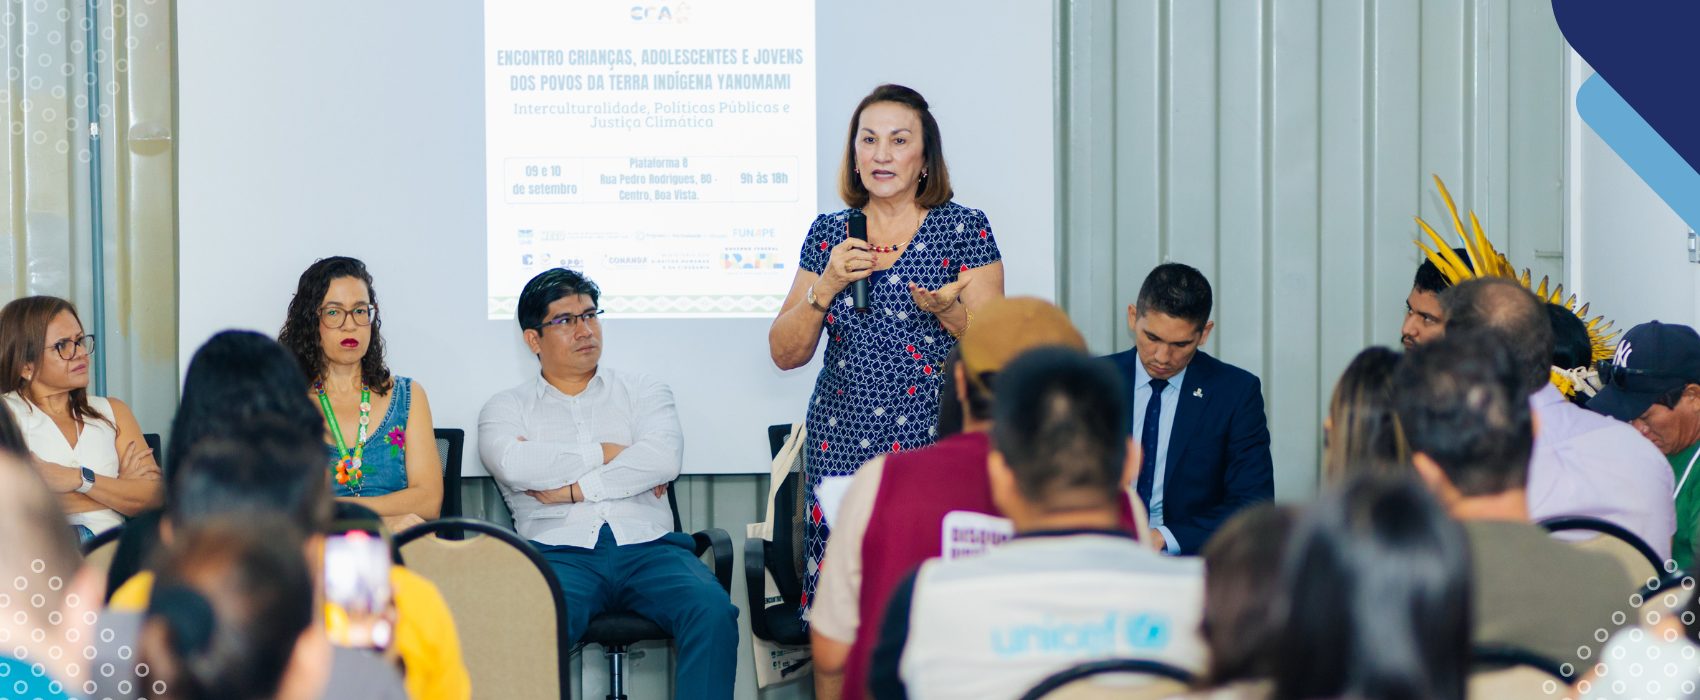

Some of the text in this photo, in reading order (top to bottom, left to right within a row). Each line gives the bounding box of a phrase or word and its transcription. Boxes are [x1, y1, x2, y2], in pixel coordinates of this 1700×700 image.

[497, 48, 804, 70] ENCONTRO CRIANÇAS, ADOLESCENTES E JOVENS
[510, 70, 791, 91] DOS POVOS DA TERRA INDÍGENA YANOMAMI
[513, 101, 790, 116] Interculturalidade, Políticas Públicas e
[590, 115, 714, 131] Justiça Climática
[629, 157, 680, 168] Plataforma
[525, 165, 561, 177] 09 e 10
[740, 171, 789, 184] 9h às 18h
[600, 174, 617, 184] Rua
[619, 174, 646, 184] Pedro
[649, 174, 698, 186] Rodrigues,
[512, 183, 578, 195] de setembro
[619, 189, 700, 201] Centro, Boa Vista.
[990, 612, 1117, 656] unicef
